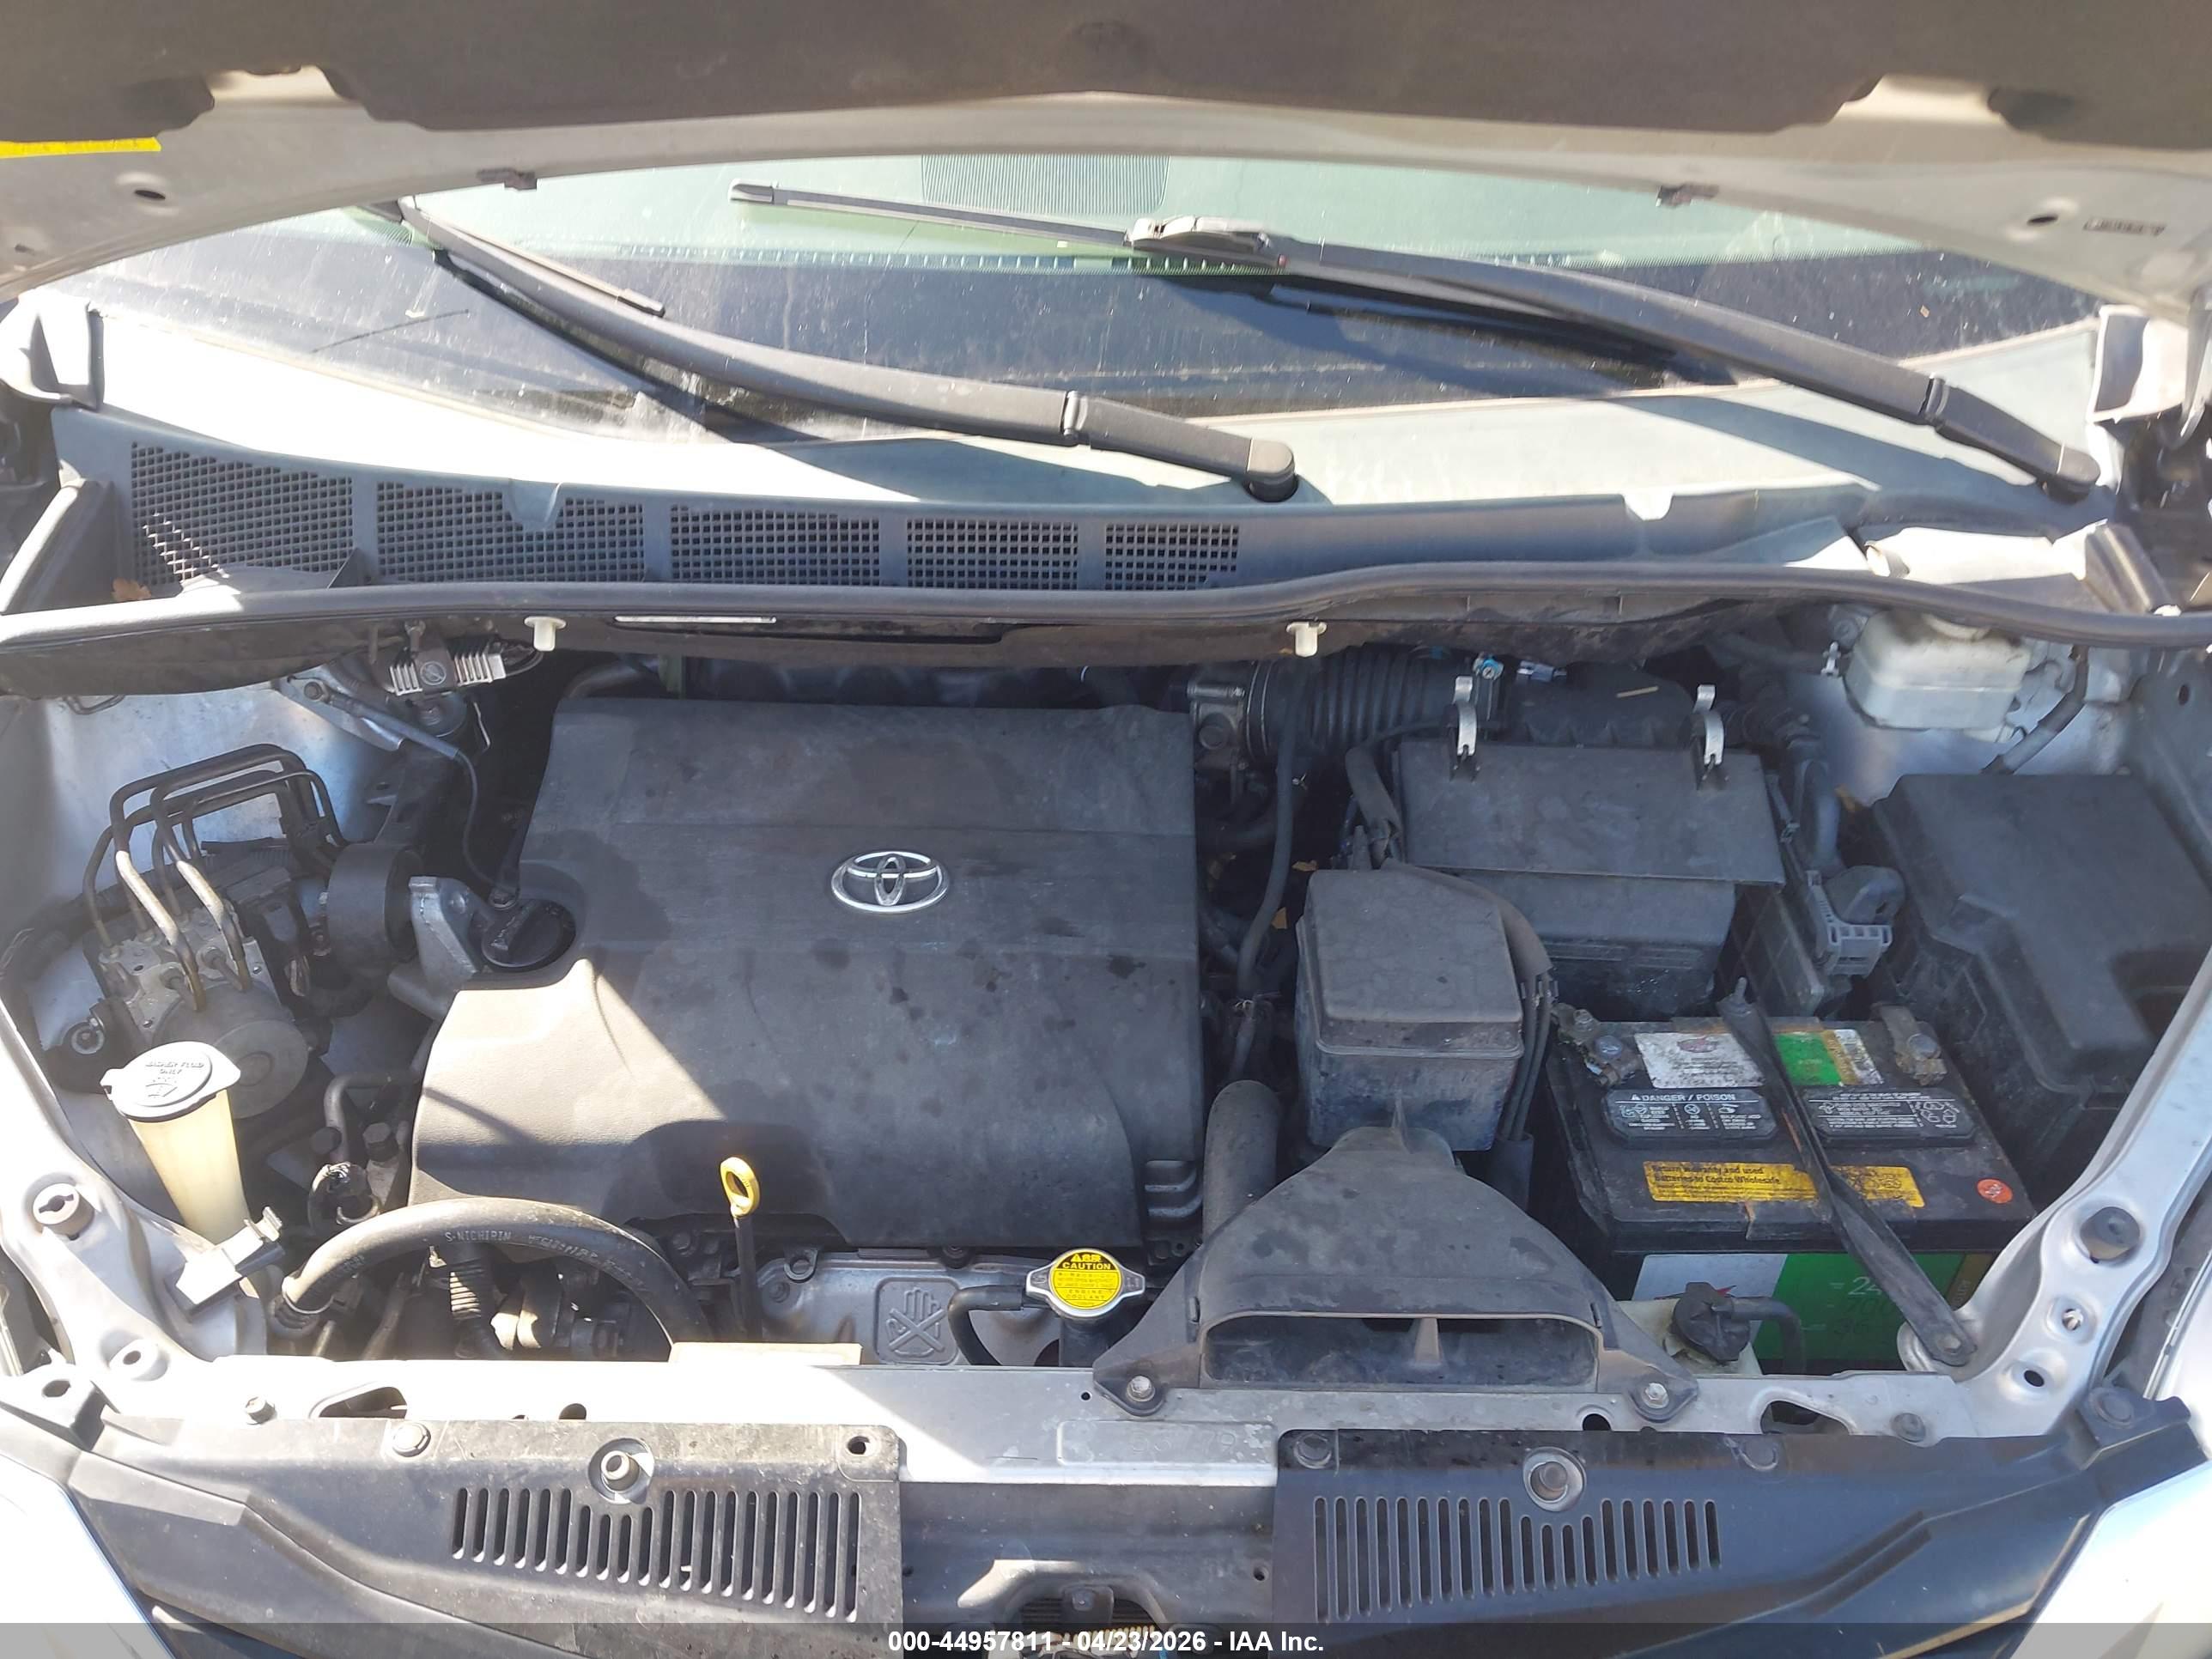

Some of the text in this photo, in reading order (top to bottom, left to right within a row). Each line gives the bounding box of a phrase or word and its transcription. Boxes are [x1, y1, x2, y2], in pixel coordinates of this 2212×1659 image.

[1723, 1166, 1741, 1175] and
[1705, 1176, 1734, 1184] Costco
[1735, 1176, 1780, 1185] Wholesale
[1061, 1261, 1111, 1270] CAUTION
